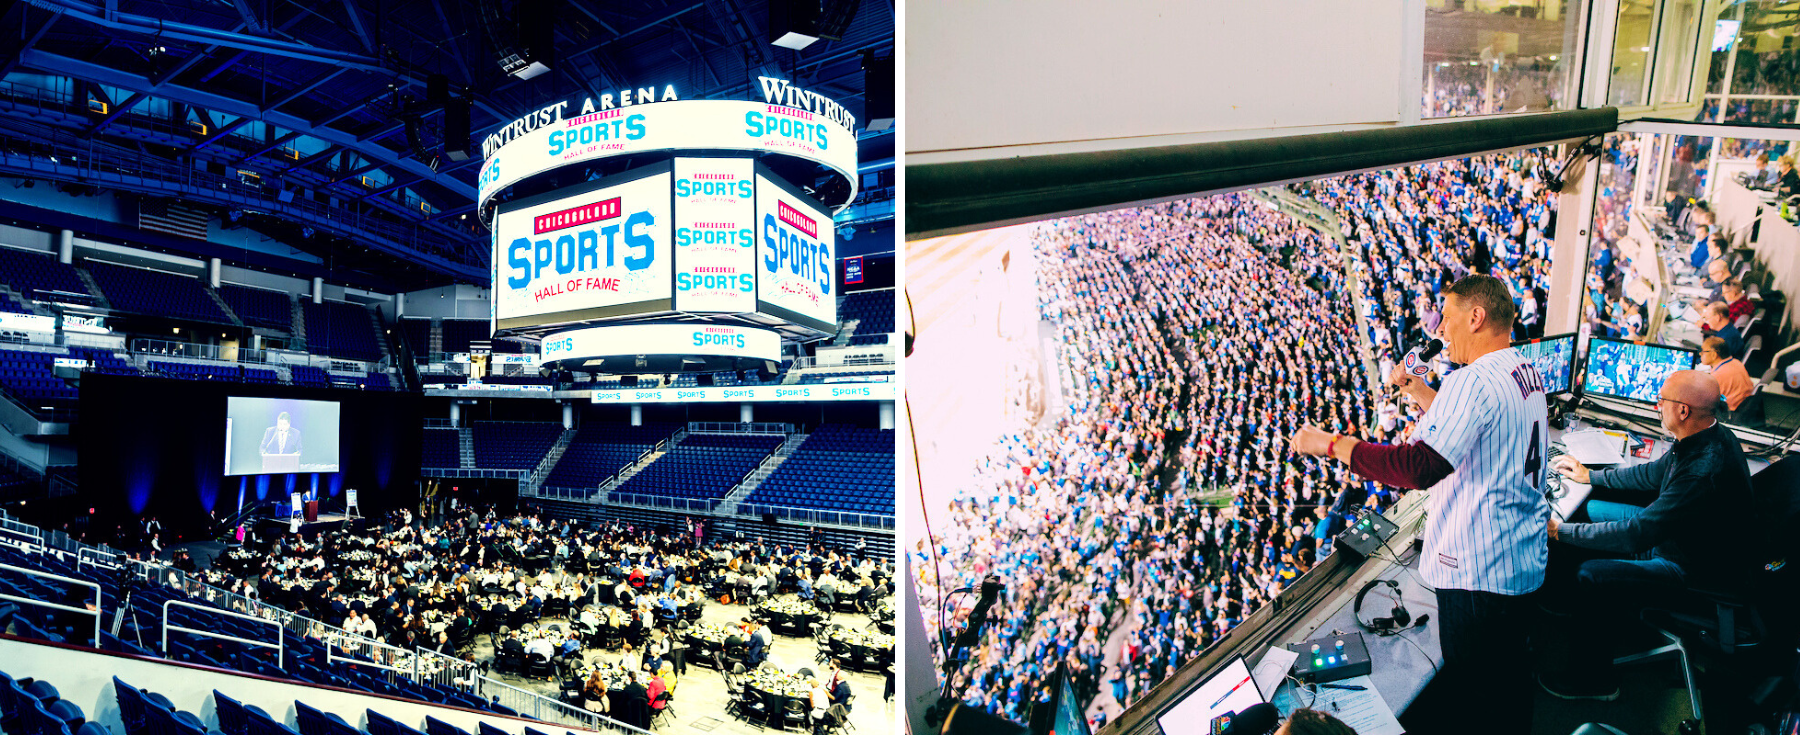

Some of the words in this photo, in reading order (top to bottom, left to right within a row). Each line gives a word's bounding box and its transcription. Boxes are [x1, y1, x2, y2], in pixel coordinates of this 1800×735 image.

[758, 75, 856, 138] WINTRUST
[481, 100, 568, 161] WINTRUST
[581, 84, 679, 115] ARENA
[745, 110, 828, 151] SPORTS
[548, 113, 647, 157] SPORTS
[677, 178, 753, 198] SPORTS
[538, 202, 615, 231] CHICAGOLAND
[677, 227, 753, 247] SPORTS
[508, 210, 655, 290] SPORTS
[763, 213, 831, 295] SPORTS
[534, 283, 564, 303] HALL
[566, 279, 583, 292] OF
[586, 277, 621, 292] FAME
[677, 272, 753, 292] SPORTS
[546, 337, 573, 354] SPORTS
[693, 331, 745, 349] SPORTS
[1510, 362, 1545, 400] RIZZ
[597, 392, 621, 400] SPORTS
[636, 391, 662, 400] SPORTS
[677, 390, 706, 399] SPORTS
[723, 389, 755, 398] SPORTS
[776, 388, 810, 398] SPORTS
[832, 387, 870, 396] SPORTS
